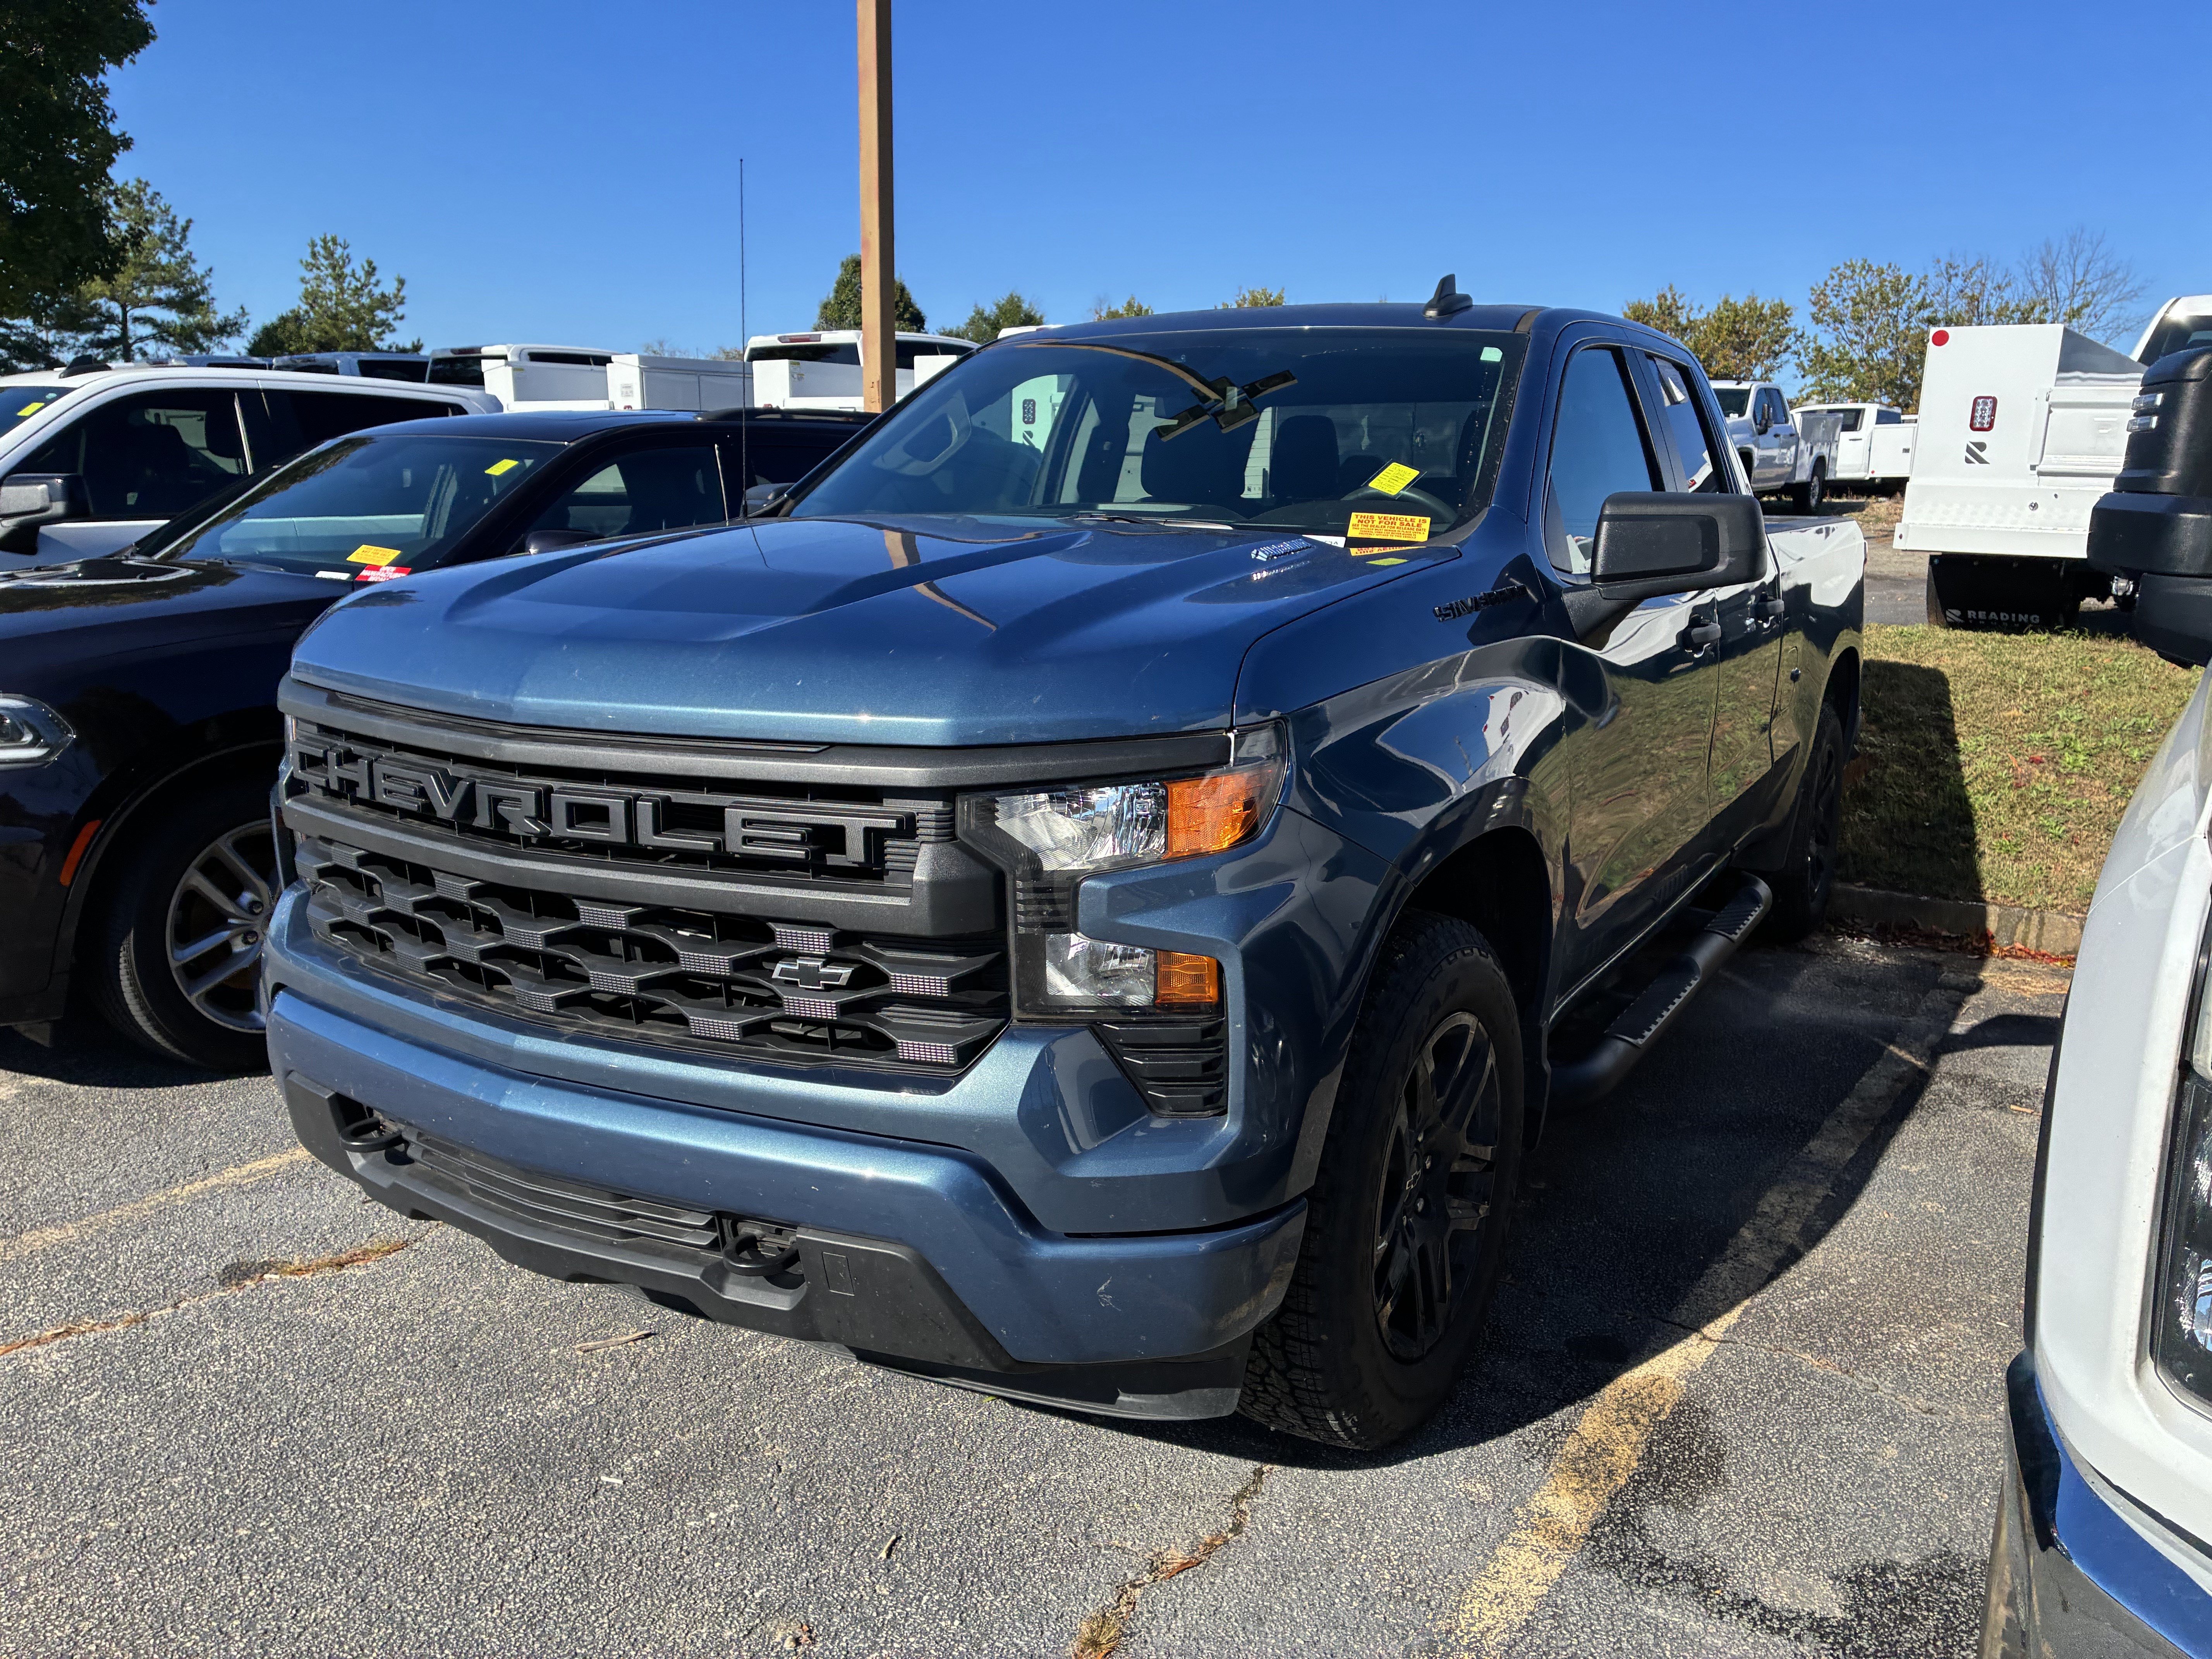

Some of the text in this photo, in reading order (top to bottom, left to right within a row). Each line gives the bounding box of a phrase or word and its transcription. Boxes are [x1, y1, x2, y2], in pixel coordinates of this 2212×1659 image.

[1433, 583, 1528, 623] SILVE
[1967, 610, 2040, 624] READING
[290, 738, 907, 864] CHEVROLET
